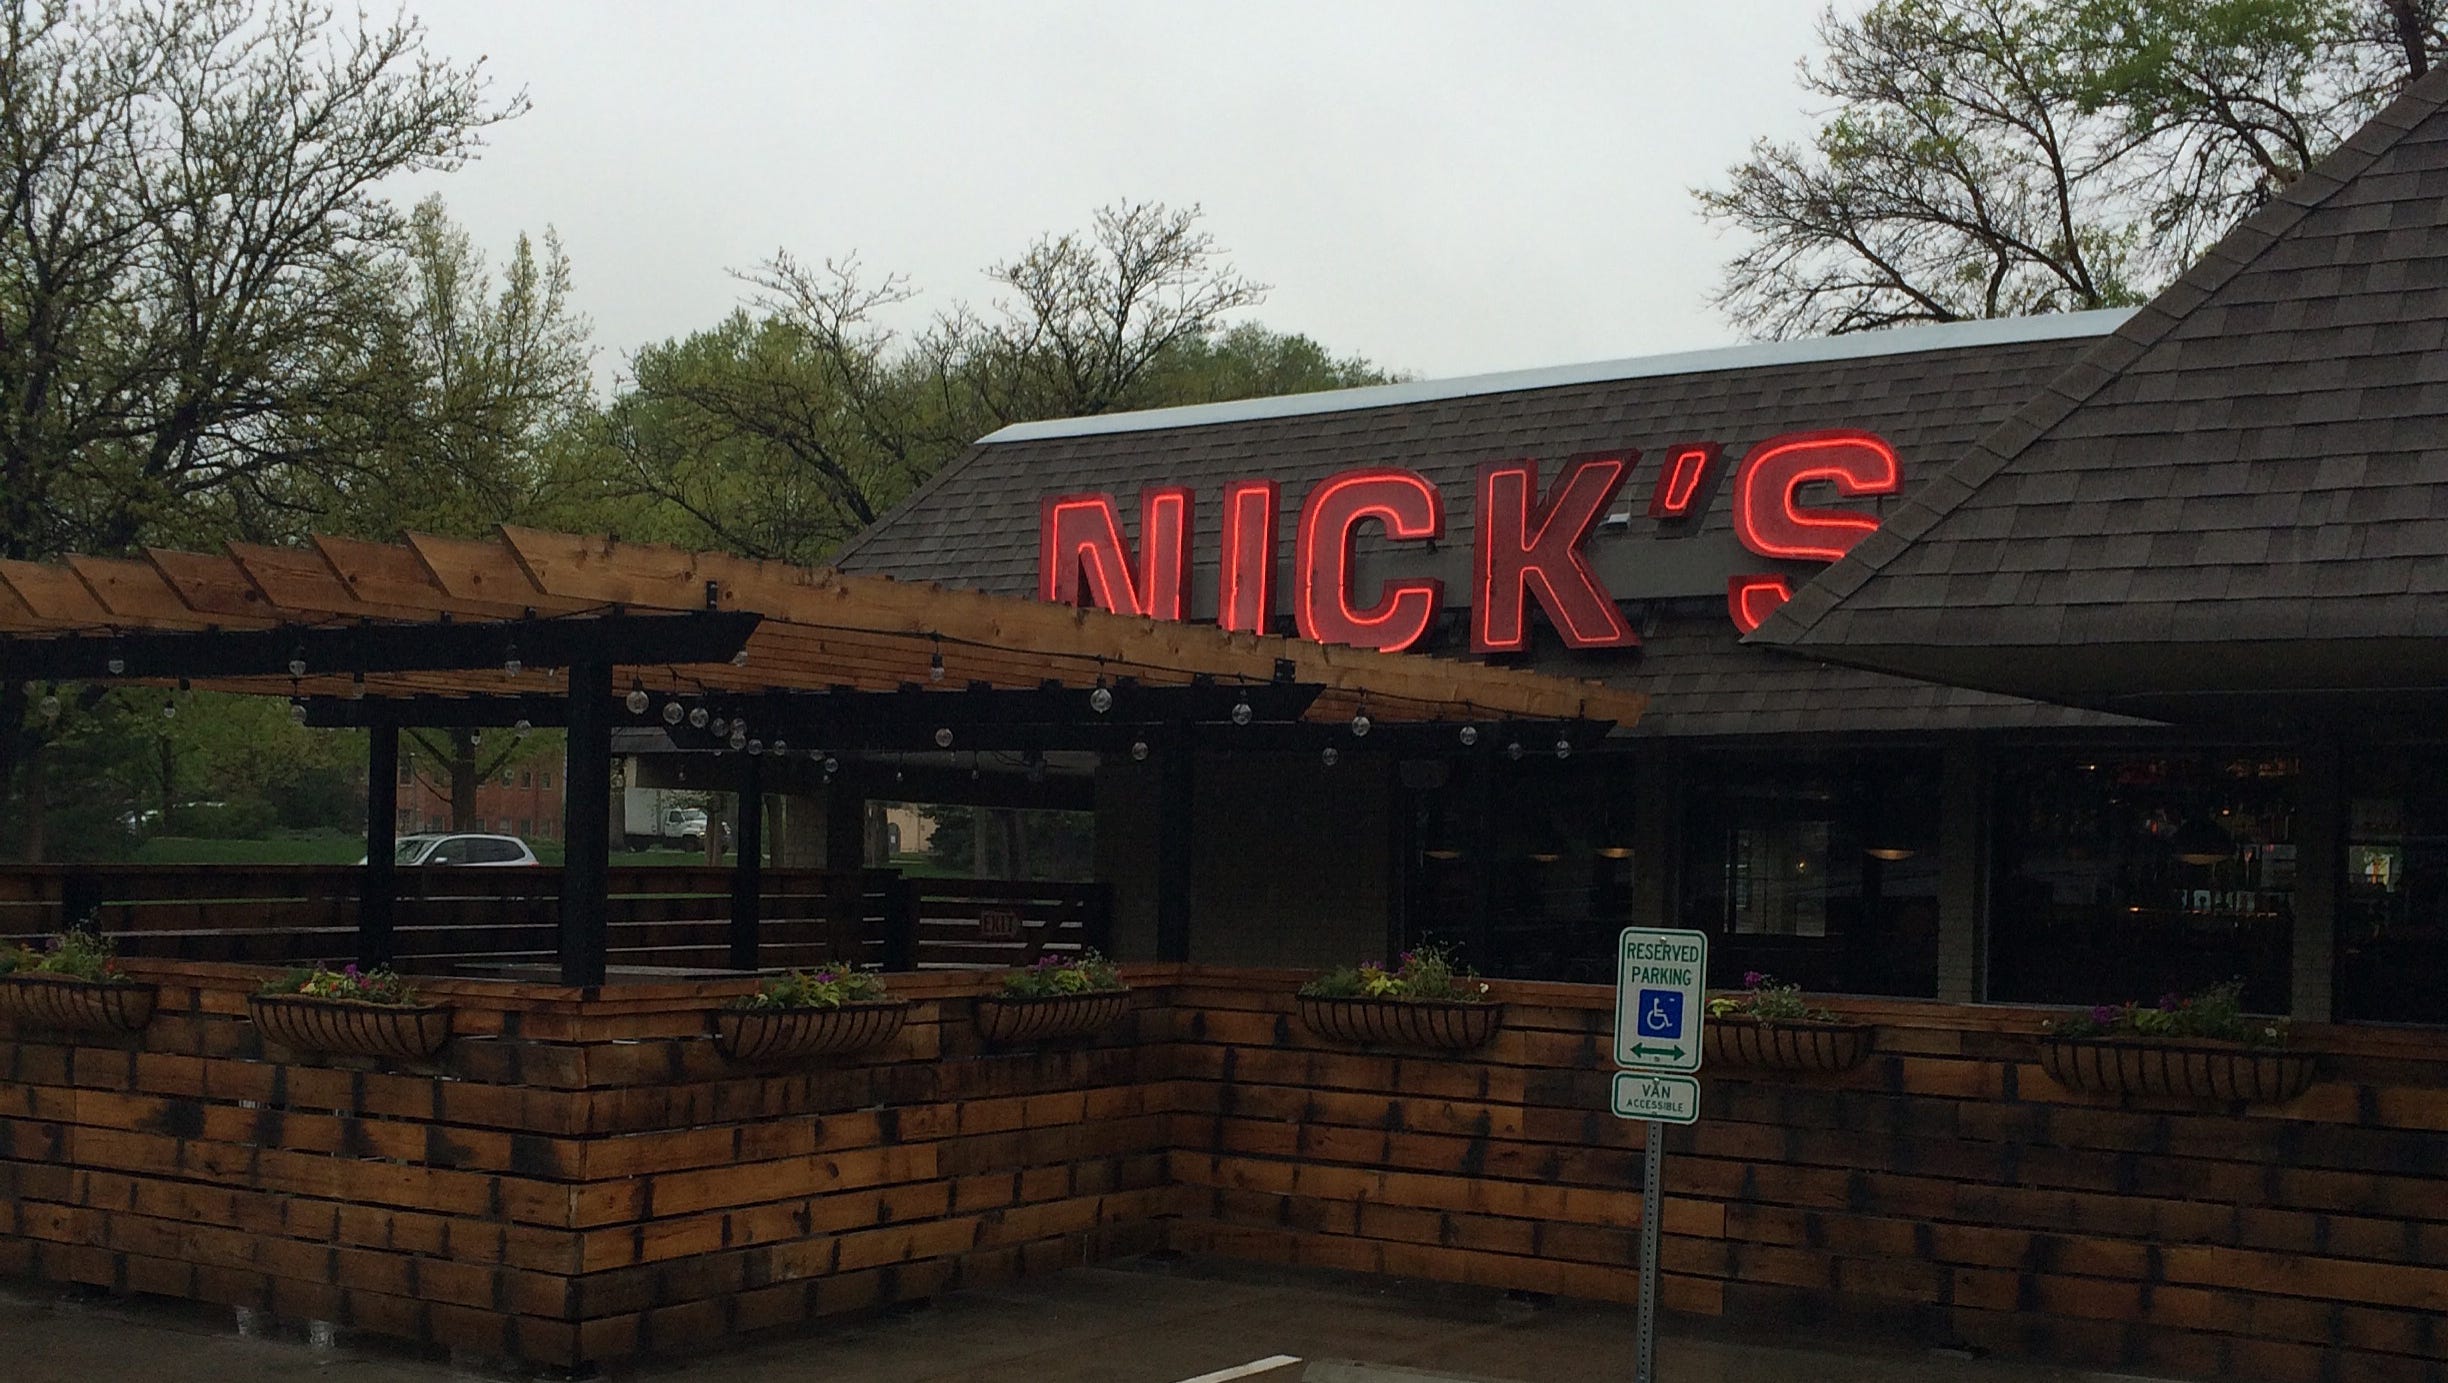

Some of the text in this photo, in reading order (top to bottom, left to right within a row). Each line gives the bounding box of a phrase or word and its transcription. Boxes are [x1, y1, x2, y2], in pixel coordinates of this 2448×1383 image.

[1039, 429, 1904, 653] NICK'S
[983, 914, 1014, 932] EXIT
[1627, 942, 1699, 962] RESERVED
[1631, 966, 1692, 985] PARKING
[1642, 1084, 1671, 1099] VAN
[1626, 1099, 1684, 1112] ACCESSIBLE
